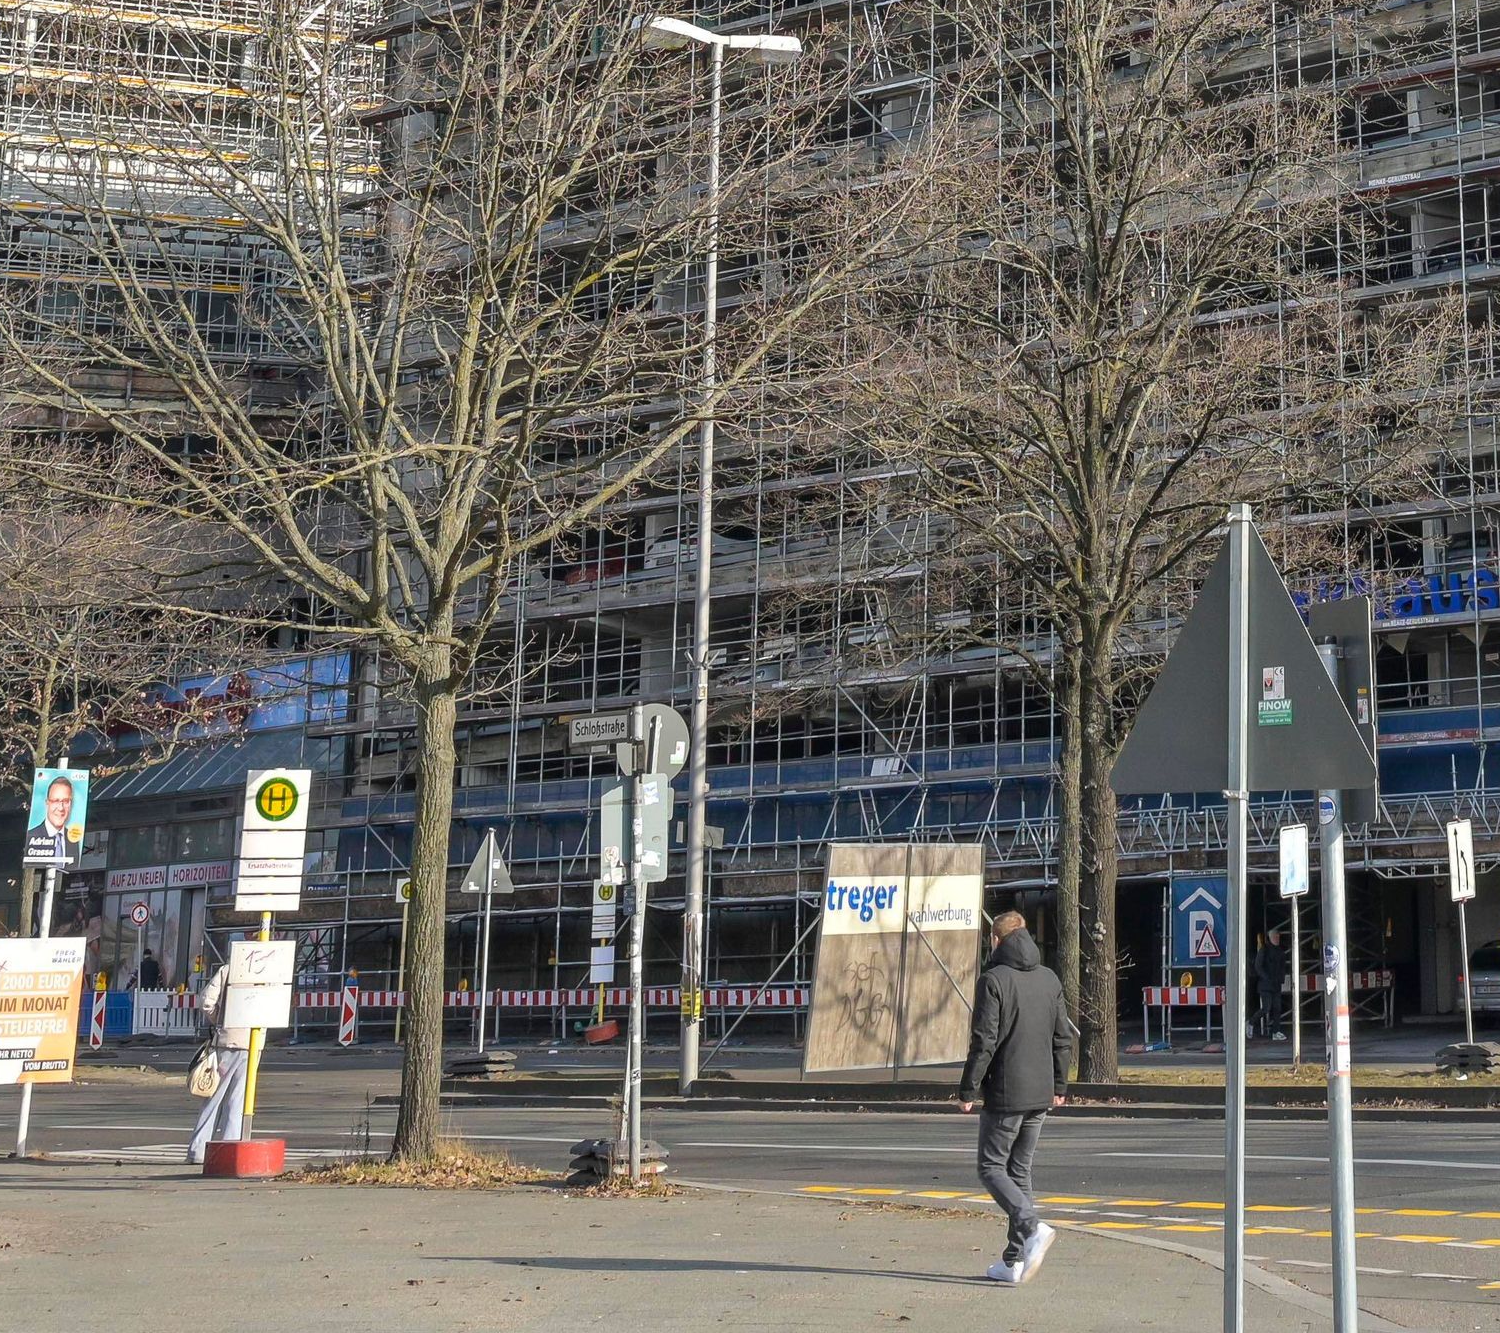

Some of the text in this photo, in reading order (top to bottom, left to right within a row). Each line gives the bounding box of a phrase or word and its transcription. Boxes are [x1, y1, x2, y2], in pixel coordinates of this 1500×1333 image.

[1259, 700, 1291, 710] FINOW
[574, 717, 625, 738] Schloßstraße
[267, 787, 287, 812] H
[29, 837, 55, 846] Adrian
[28, 848, 55, 856] Grasse
[111, 874, 124, 888] AUF
[127, 873, 137, 886] ZU
[140, 871, 165, 886] NEUEN
[827, 880, 898, 923] treger
[908, 904, 972, 925] wahlwerbung
[1189, 911, 1215, 959] P
[3, 974, 71, 990] 2000 EURO
[0, 997, 69, 1012] IM MONAT
[10, 1049, 34, 1059] NETTO
[24, 1061, 67, 1071] VOM BRUTTO
